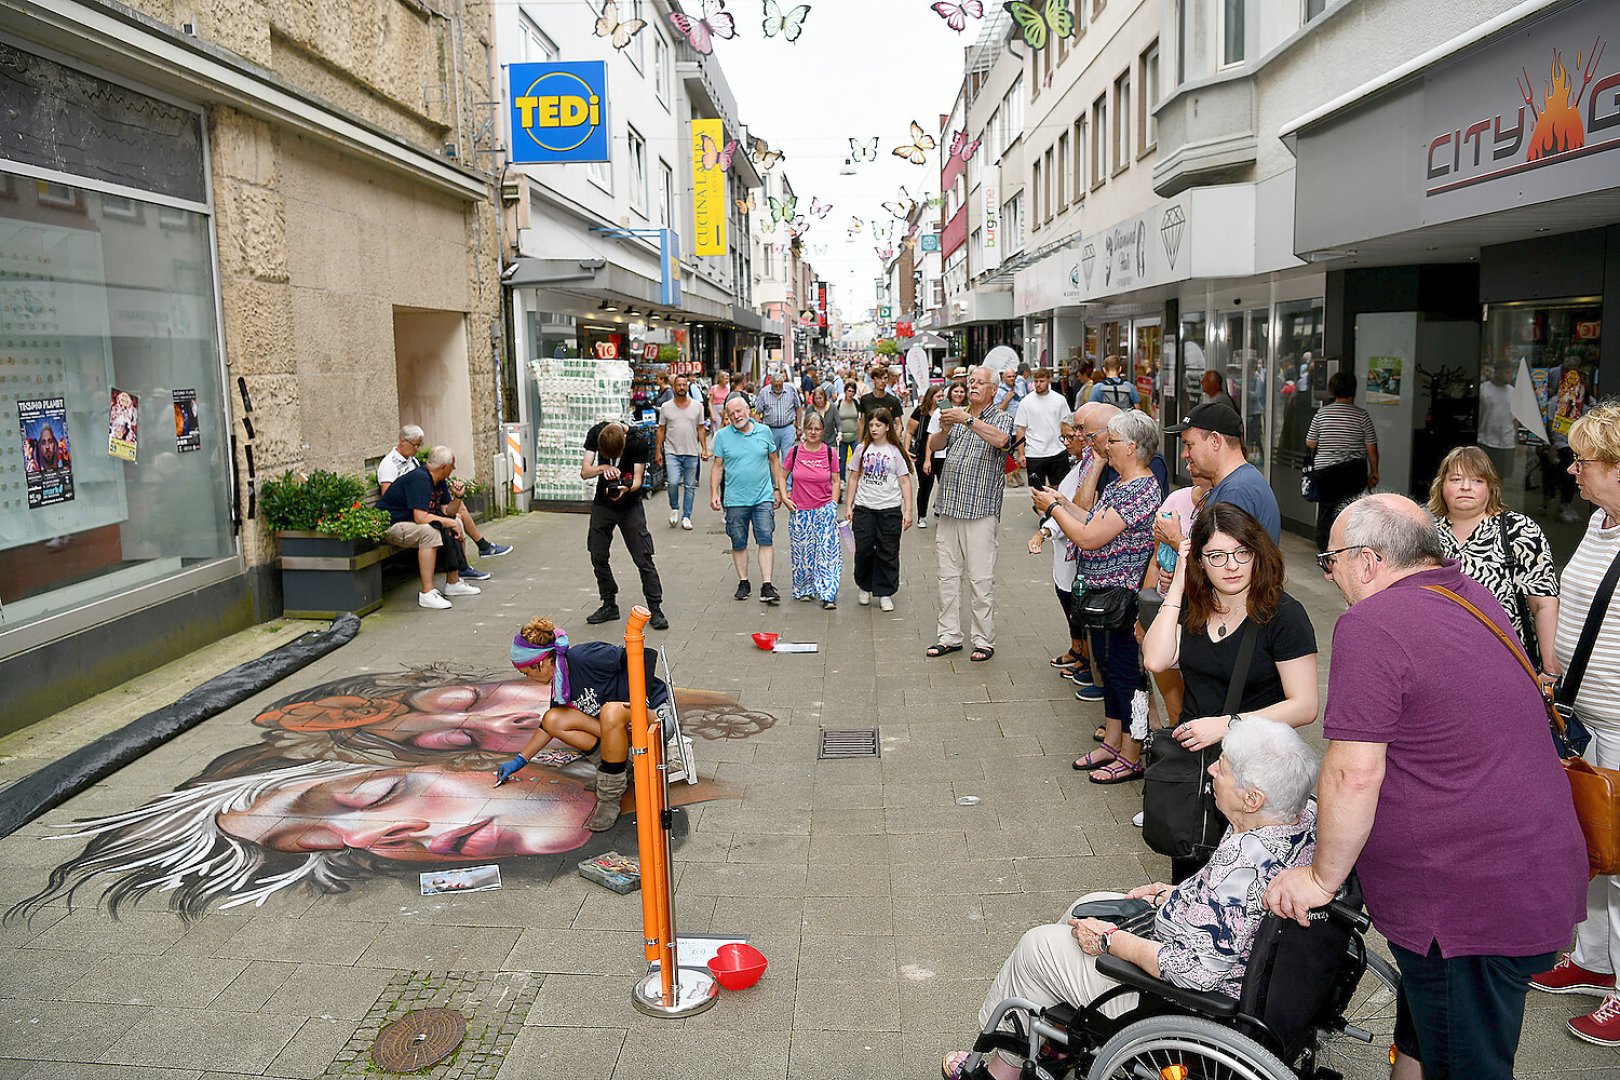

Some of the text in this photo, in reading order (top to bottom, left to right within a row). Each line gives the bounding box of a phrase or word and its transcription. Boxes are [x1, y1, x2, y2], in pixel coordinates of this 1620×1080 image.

[515, 94, 600, 129] TEDi
[1427, 106, 1526, 180] CITY
[696, 189, 709, 246] CUCINA
[984, 188, 996, 248] burgerme
